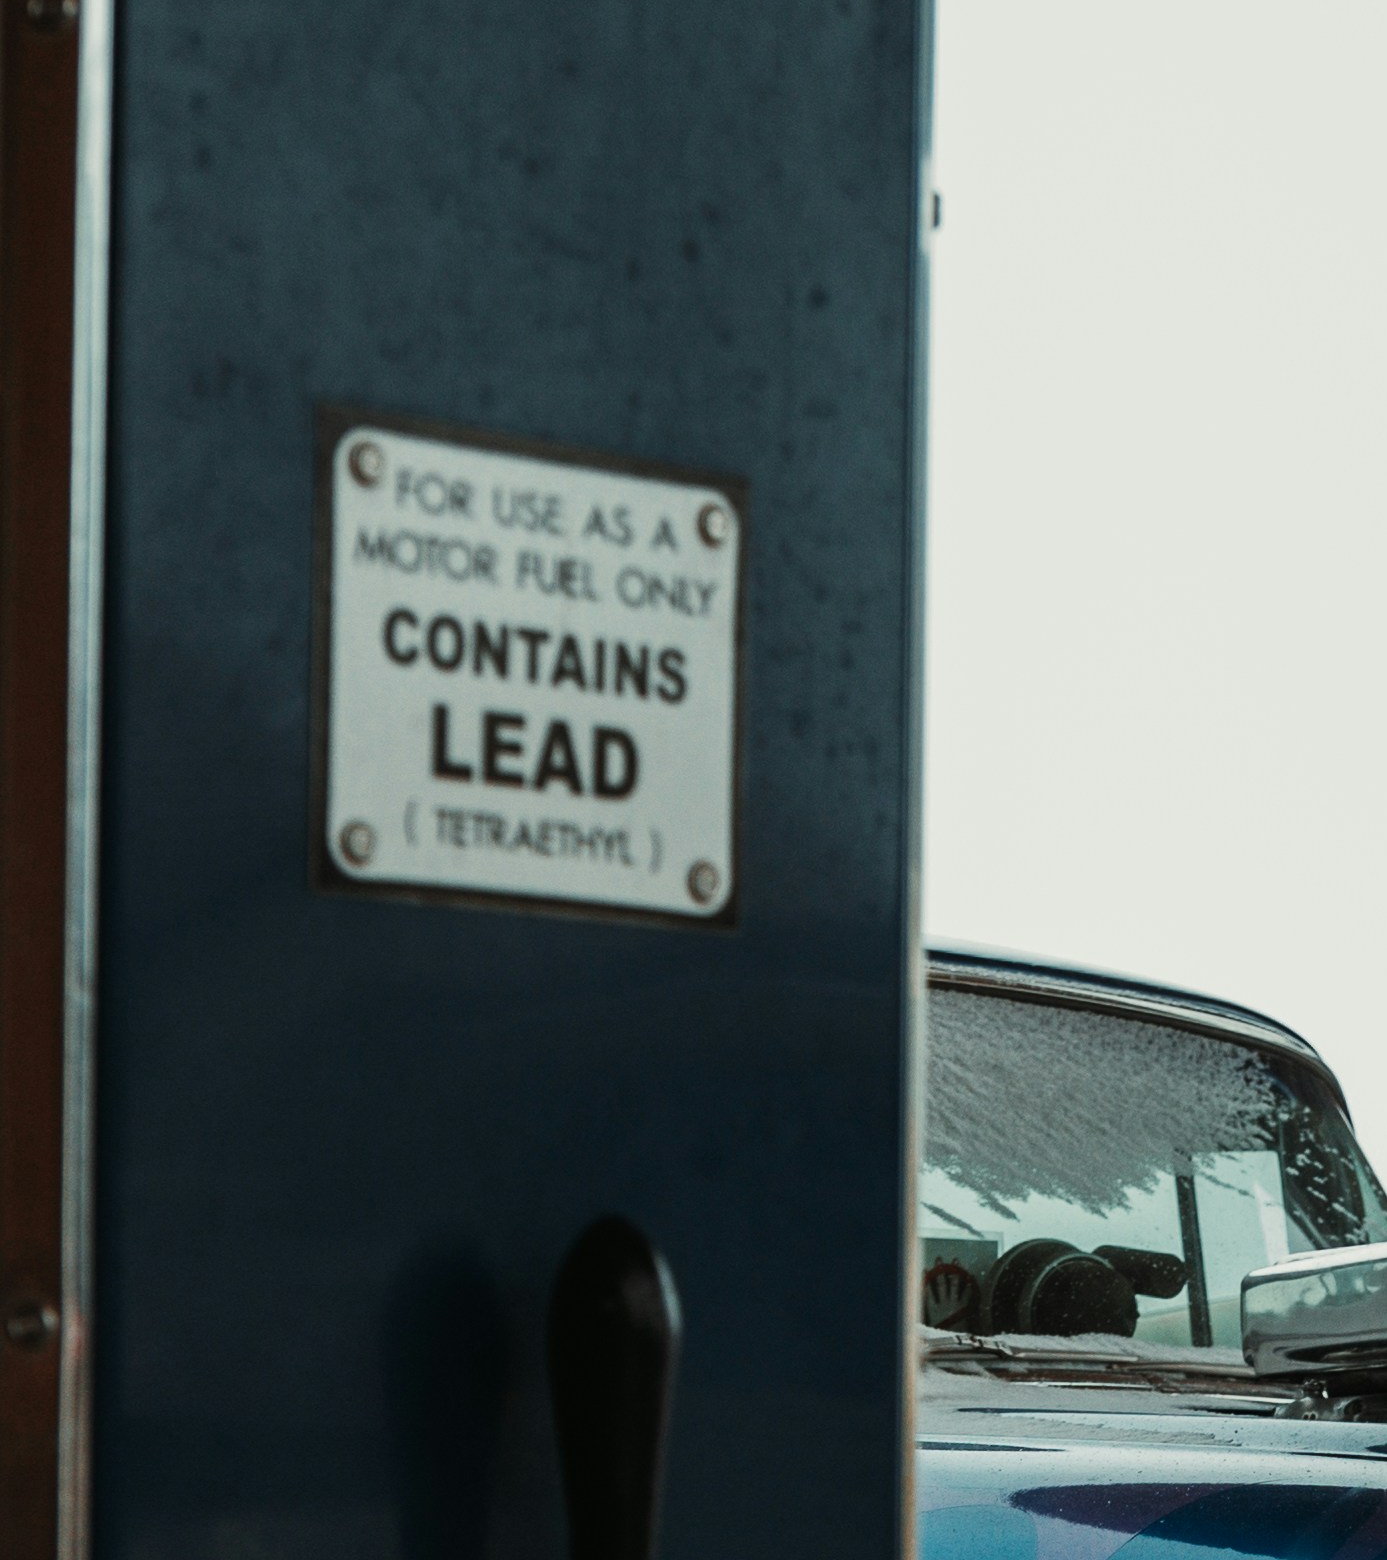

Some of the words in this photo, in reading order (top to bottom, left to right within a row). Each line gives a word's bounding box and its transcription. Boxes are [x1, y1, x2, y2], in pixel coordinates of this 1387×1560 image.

[395, 466, 474, 517] FOR
[491, 486, 564, 537] USE
[585, 504, 632, 547] AS
[650, 517, 681, 552] A
[352, 529, 498, 587] MOTOR
[515, 549, 599, 603] FUEL
[615, 565, 720, 618] ONLY
[382, 607, 688, 706] CONTAINS
[431, 703, 641, 801] LEAD
